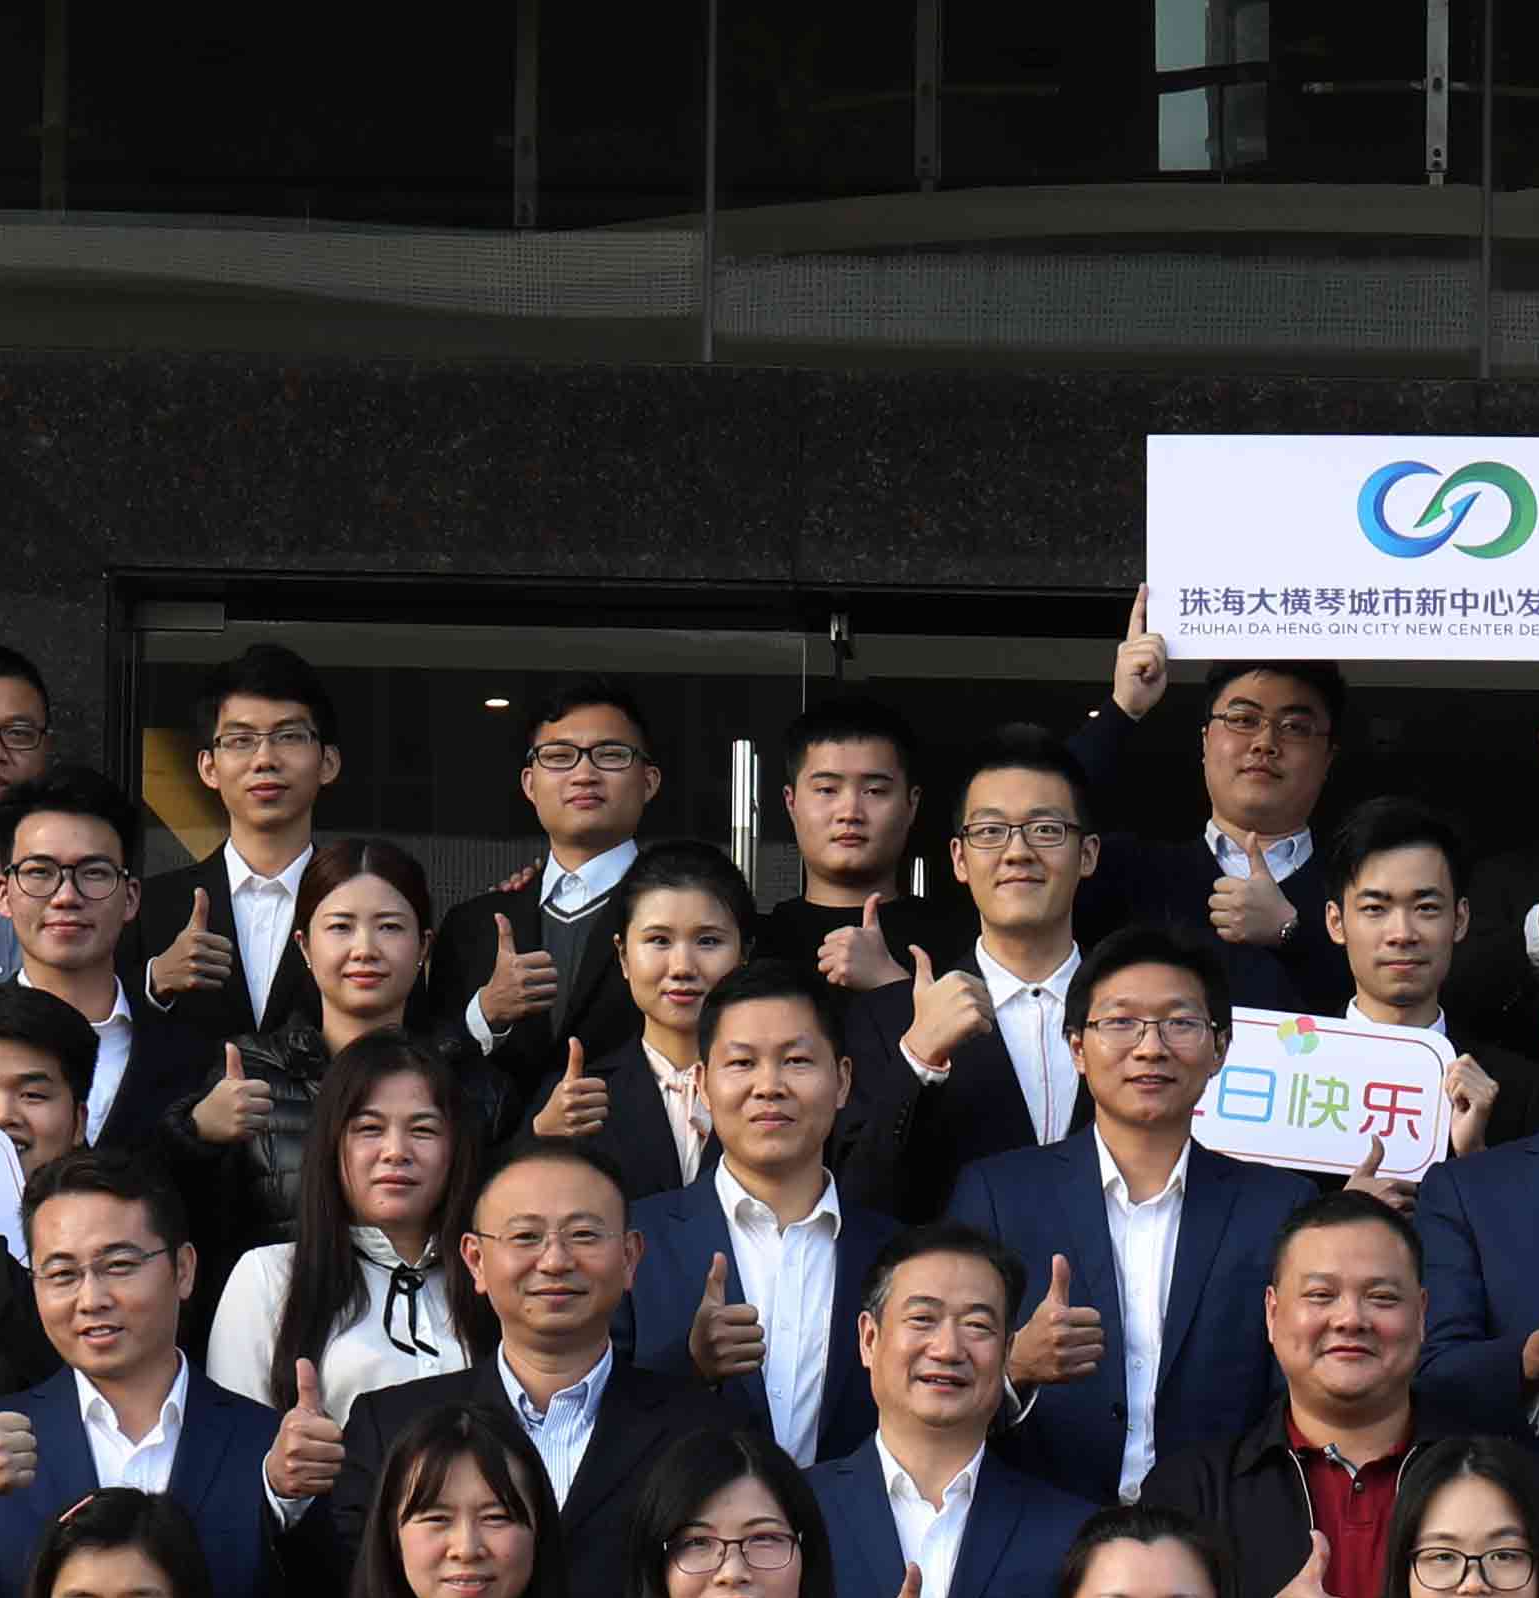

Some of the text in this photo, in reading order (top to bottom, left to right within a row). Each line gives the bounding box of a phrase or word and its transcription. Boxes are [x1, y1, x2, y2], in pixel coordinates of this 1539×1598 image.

[1179, 622, 1243, 635] ZHUHAI
[1248, 622, 1272, 635] DA
[1276, 622, 1323, 635] HENG
[1328, 622, 1358, 635] QIN
[1363, 622, 1400, 635] CITY
[1406, 622, 1443, 636] NEW
[1447, 623, 1513, 637] CENTER
[1189, 1064, 1424, 1141] 日快乐
